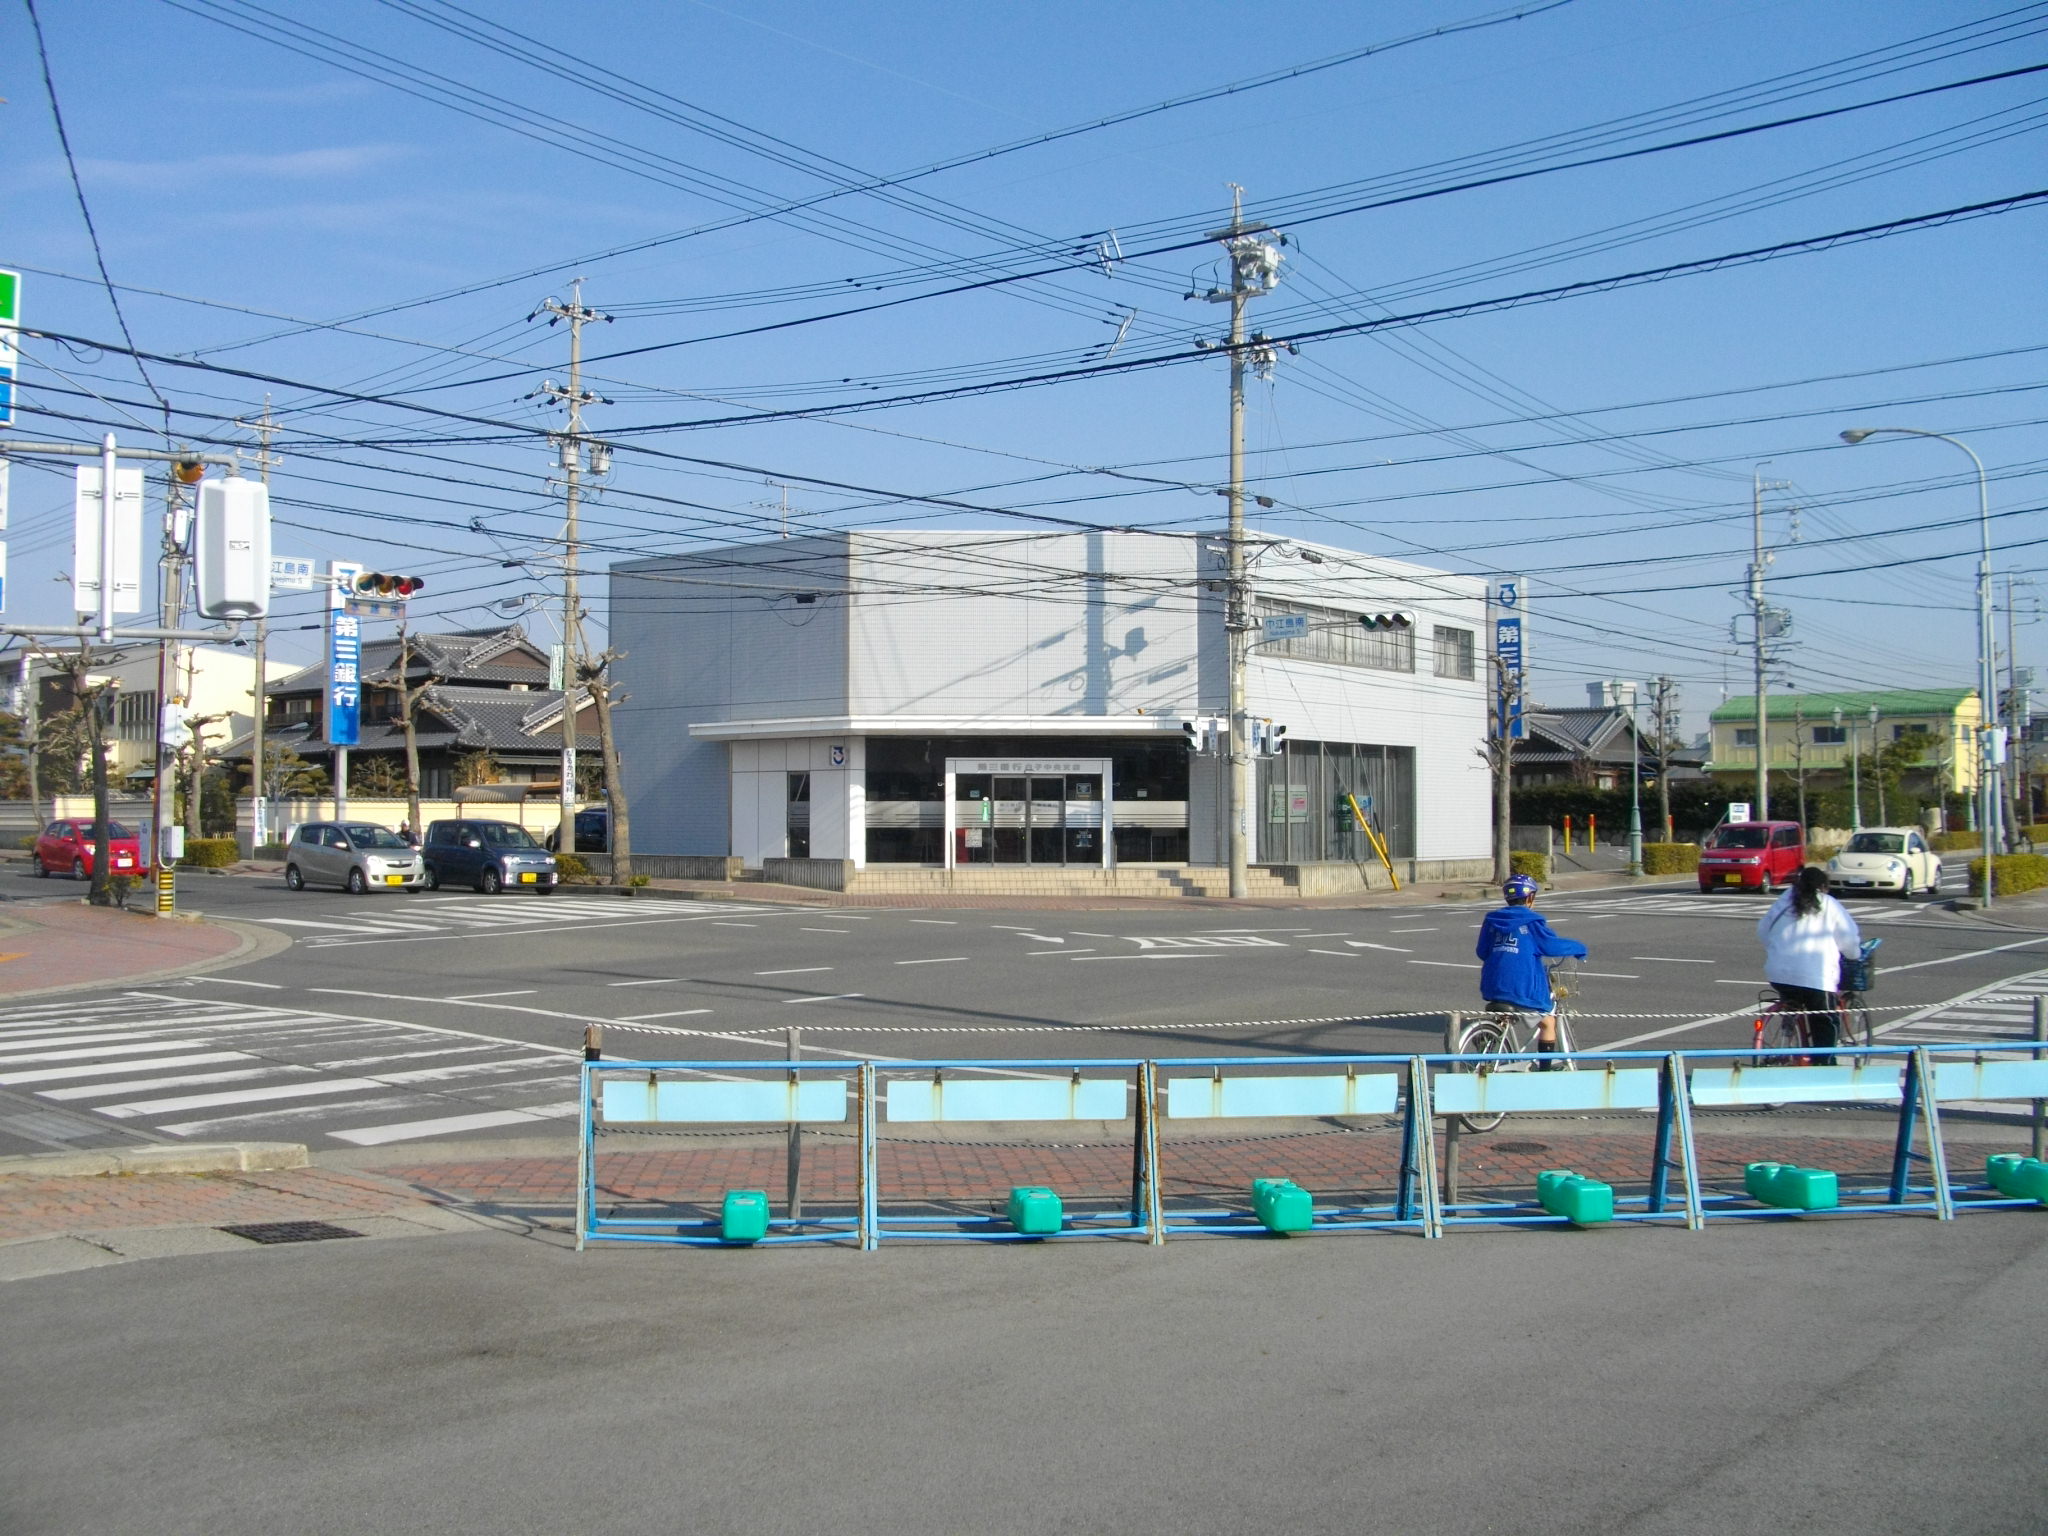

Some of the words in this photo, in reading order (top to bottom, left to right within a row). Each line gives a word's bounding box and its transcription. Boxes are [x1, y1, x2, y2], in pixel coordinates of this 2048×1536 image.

[334, 616, 357, 706] 第三銀行
[1499, 626, 1518, 706] 第三
